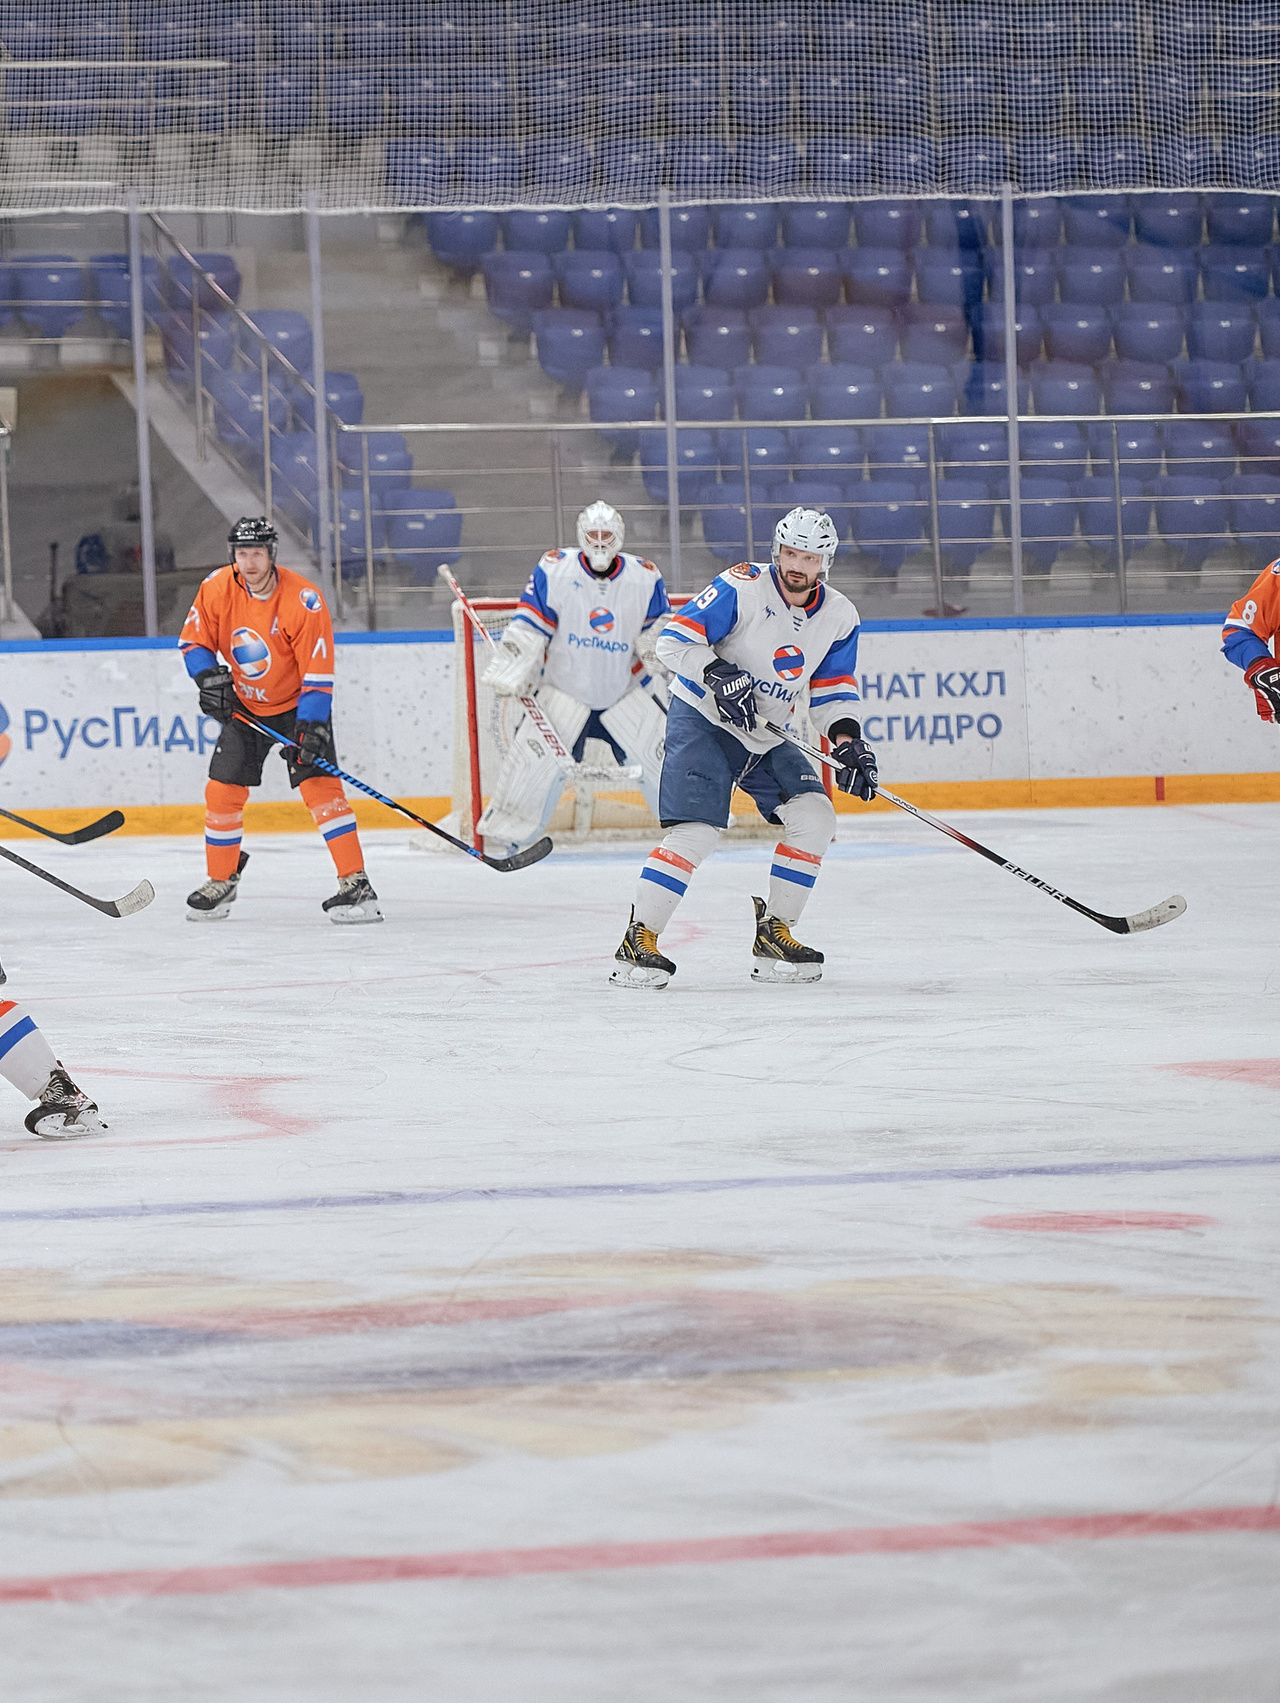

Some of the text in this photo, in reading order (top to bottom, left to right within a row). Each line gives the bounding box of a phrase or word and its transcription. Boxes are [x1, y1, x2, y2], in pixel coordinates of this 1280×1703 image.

[1242, 600, 1258, 625] 8
[861, 670, 1007, 701] НАТ КХЛ
[521, 696, 566, 758] BAUER
[863, 712, 1003, 746] СГИДРО
[892, 795, 918, 813] VAPOR
[1001, 861, 1068, 902] BAUER
